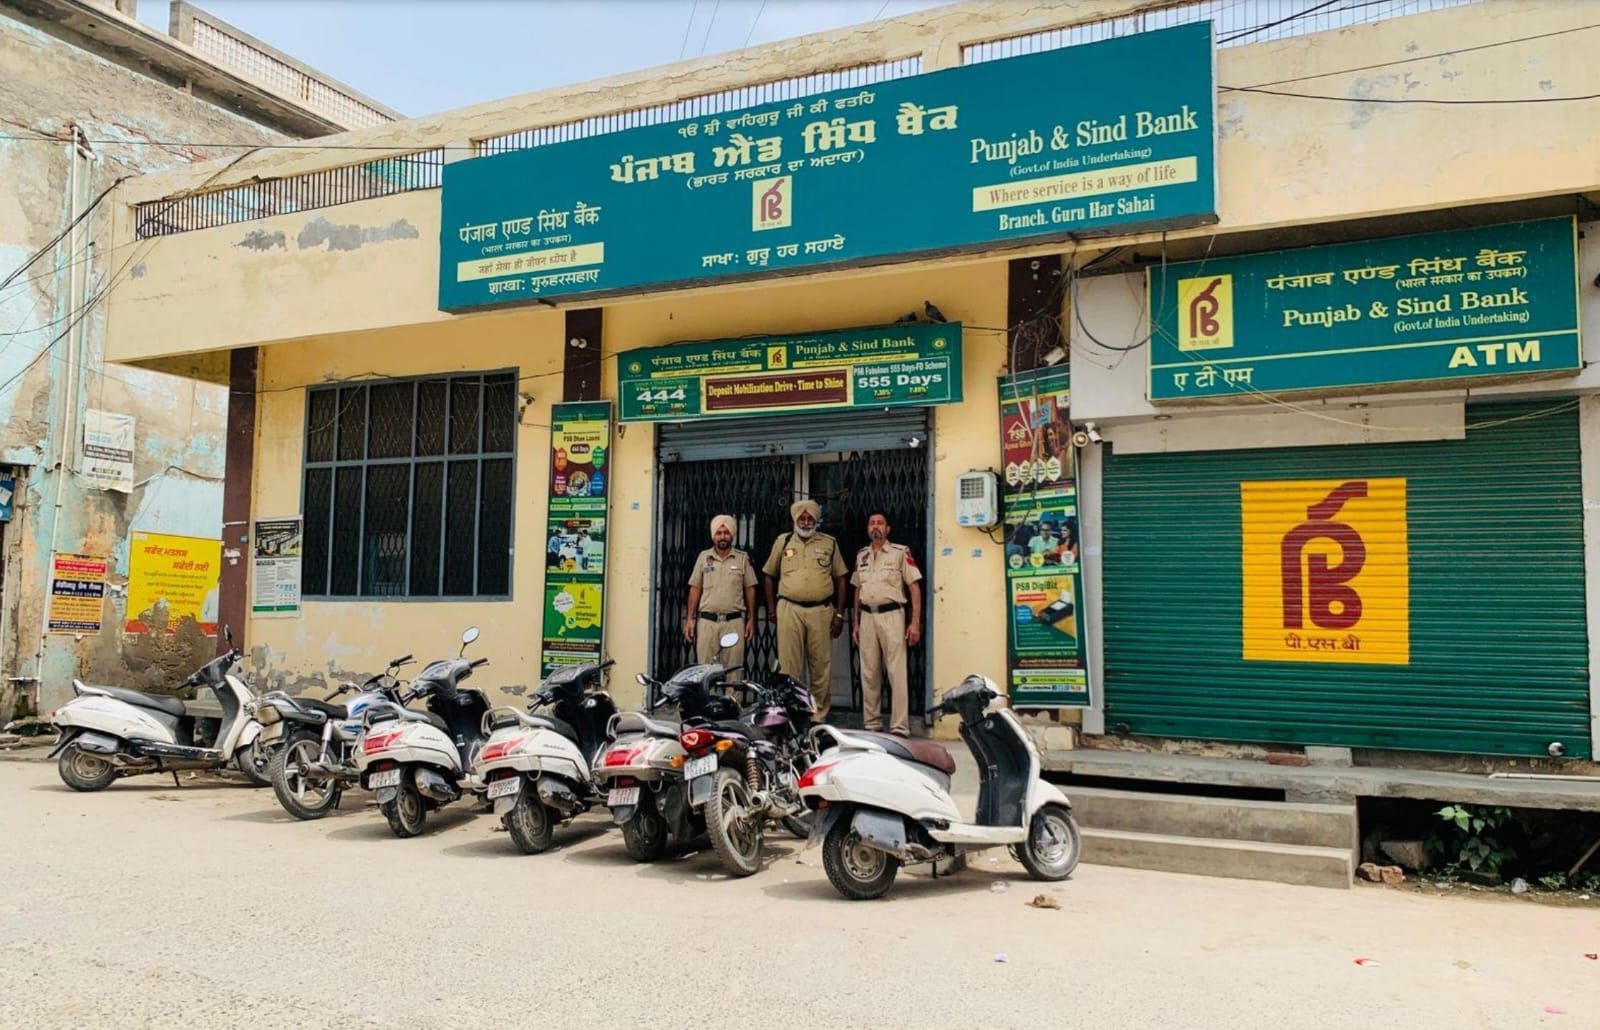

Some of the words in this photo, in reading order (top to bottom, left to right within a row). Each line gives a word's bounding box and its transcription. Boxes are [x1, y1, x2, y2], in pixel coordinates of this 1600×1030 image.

[786, 103, 804, 119] ਜੀ
[810, 98, 829, 114] ਕੀ
[609, 152, 696, 184] ਪੰਜਾਬ
[712, 132, 783, 168] ਐਂਡ
[801, 117, 877, 154] ਸਿੰਧ
[896, 102, 958, 136] ਬੈਂਕ
[970, 129, 1044, 165] Punjab
[1050, 125, 1070, 151] &
[1076, 114, 1128, 148] Sind
[1135, 104, 1199, 138] Bank
[686, 172, 729, 190] (ਭਾਰਤ
[734, 163, 782, 181] ਸਰਕਾਰ
[787, 159, 804, 172] ਦਾ
[810, 148, 865, 168] ਅਦਾਰਾ)
[1053, 156, 1080, 171] India
[1082, 147, 1152, 168] Undertaking)
[990, 188, 1030, 205] Where
[1033, 180, 1078, 199] service
[1082, 176, 1093, 191] is
[1096, 178, 1104, 190] a
[1107, 172, 1134, 192] way
[1136, 167, 1150, 184] of
[1153, 164, 1177, 182] life
[459, 222, 498, 244] पंजाब
[502, 217, 534, 240] एण्ड
[537, 208, 570, 232] सिंध
[574, 202, 602, 226] बैंक
[998, 209, 1049, 231] Branch.
[1052, 205, 1086, 224] Guru
[1088, 201, 1115, 218] Har
[1117, 194, 1156, 216] Sahai
[482, 244, 503, 256] (भारत
[505, 240, 529, 250] सरकार
[530, 238, 541, 246] का
[746, 248, 771, 266] ਗੁਰੂ
[776, 243, 800, 258] ਹਰ
[804, 234, 846, 254] ਸਹਾਏ
[1266, 272, 1336, 290] पंजाब
[1343, 264, 1400, 285] एण्ड
[1407, 256, 1467, 276] सिंध
[1475, 249, 1527, 268] बैंक
[488, 279, 526, 294] शाखा:
[1395, 278, 1427, 292] (भारत
[1430, 273, 1464, 286] सरकार
[1466, 272, 1482, 282] का
[1282, 304, 1362, 328] Punjab
[1368, 301, 1390, 319] &
[1396, 294, 1452, 316] Sind
[1460, 286, 1530, 310] Bank
[1435, 317, 1460, 329] India
[1463, 310, 1530, 326] Undertaking)
[795, 342, 836, 355] Punjab
[838, 342, 848, 352] &
[851, 339, 878, 351] Sind
[882, 336, 916, 348] Bank
[1448, 340, 1541, 369] ATM
[924, 360, 947, 370] Scheme
[708, 384, 732, 398] Deposit
[734, 382, 774, 395] Mobilization
[774, 381, 793, 392] Drive
[797, 380, 814, 391] Time
[816, 380, 823, 390] to
[824, 377, 844, 388] Shine
[858, 376, 891, 388] 555
[896, 374, 943, 386] Days
[1173, 372, 1190, 392] ए
[1194, 366, 1218, 388] टी
[1223, 368, 1254, 388] एम
[636, 388, 687, 402] 444
[1016, 582, 1030, 591] PSB
